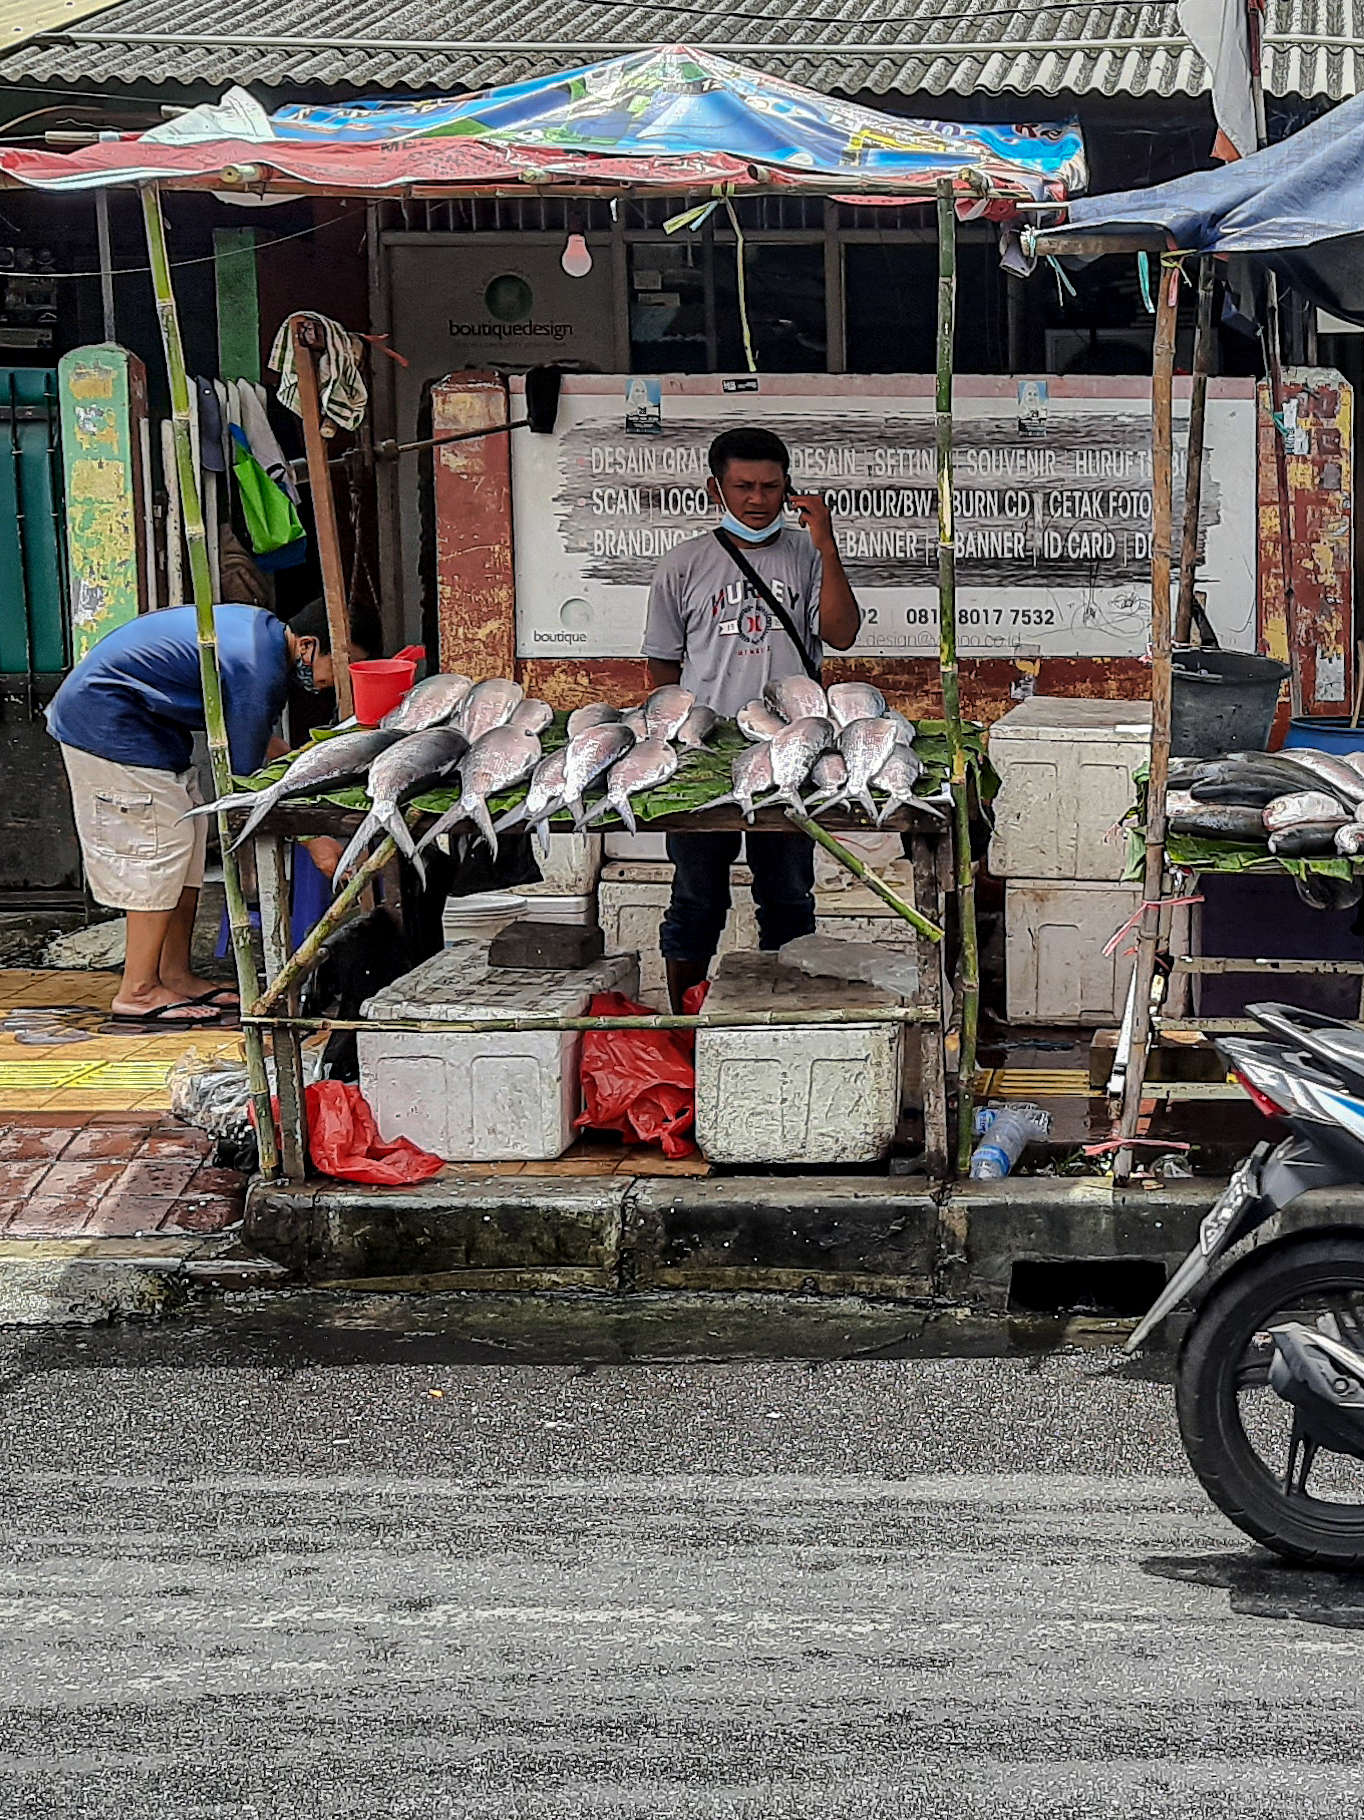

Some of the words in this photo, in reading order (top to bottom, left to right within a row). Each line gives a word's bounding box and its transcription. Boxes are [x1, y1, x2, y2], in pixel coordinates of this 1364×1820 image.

[449, 320, 573, 341] boutiquedesign
[591, 447, 655, 474] DESAIN
[662, 447, 708, 474] GRAF
[791, 447, 856, 475] DESAIN
[874, 448, 938, 476] SETTIN
[967, 449, 1056, 477] SOUVENIR
[1075, 449, 1135, 477] HURUF
[592, 488, 641, 515] SCAN
[660, 487, 709, 516] LOGO
[824, 488, 932, 518] COLOUR/BW
[953, 489, 998, 518] BURN
[1004, 489, 1031, 518] CD
[1050, 490, 1102, 518] CETAK
[1109, 490, 1152, 518] FOTO
[846, 530, 918, 558] BANNER
[1044, 532, 1062, 559] ID
[1067, 531, 1116, 560] CARD
[712, 577, 799, 616] HUREY
[905, 608, 938, 626] 081
[957, 609, 1002, 627] 8017
[1011, 609, 1055, 627] 7532
[533, 630, 588, 646] boutique
